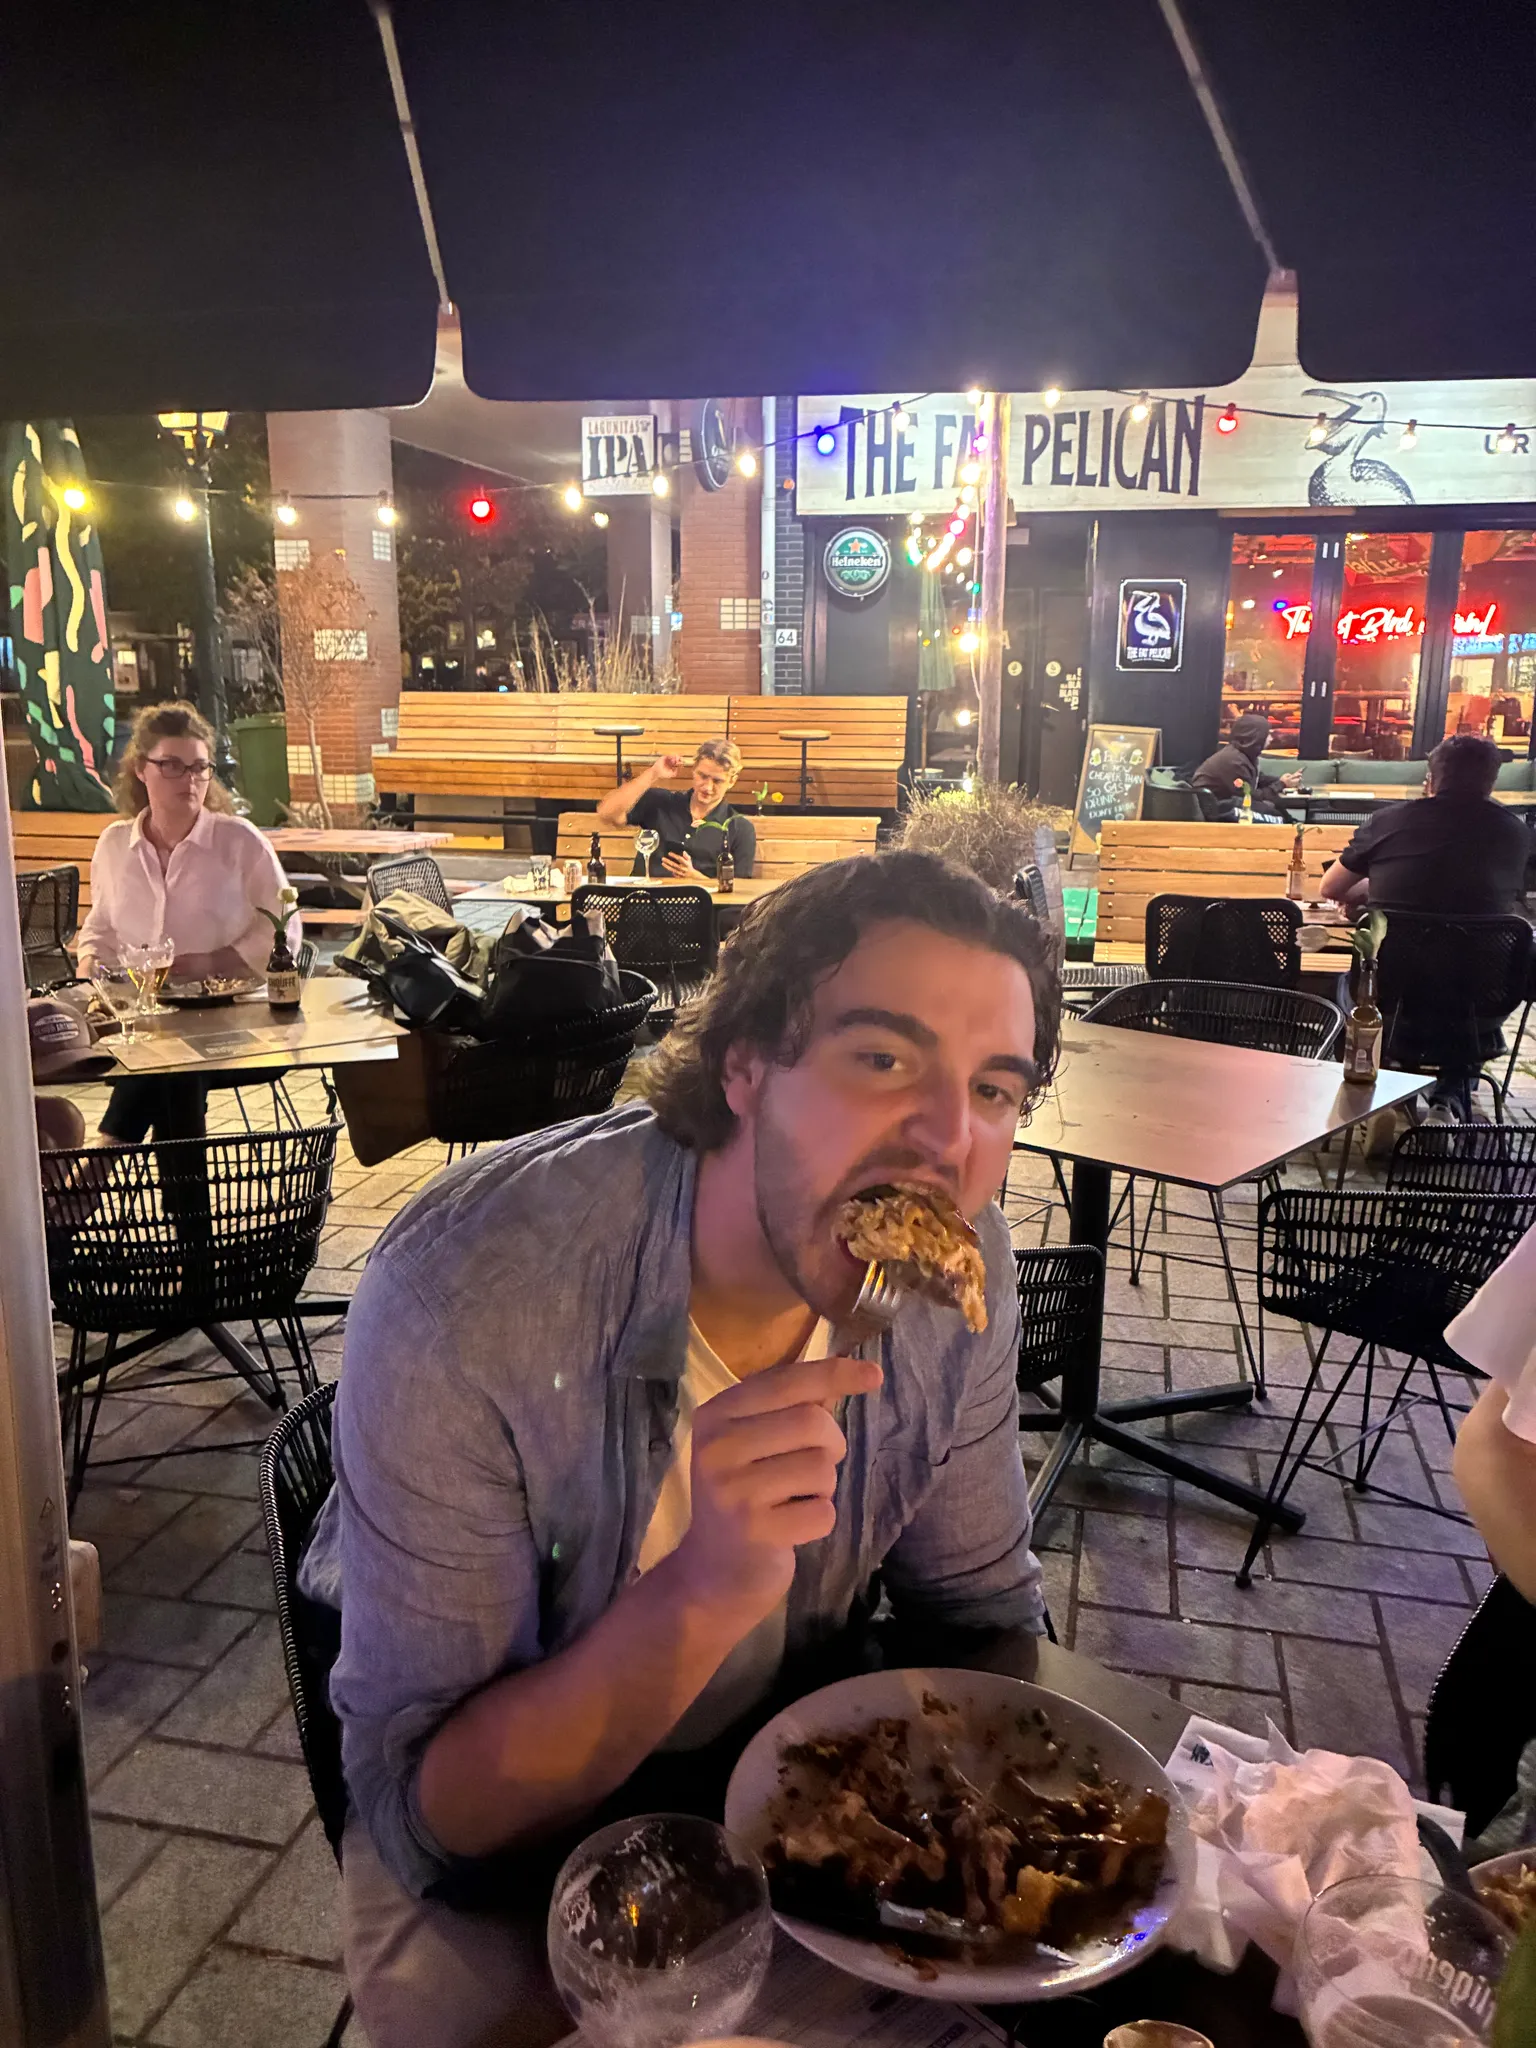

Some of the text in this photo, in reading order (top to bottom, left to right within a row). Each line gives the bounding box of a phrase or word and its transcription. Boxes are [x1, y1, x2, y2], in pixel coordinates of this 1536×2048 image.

[588, 420, 640, 435] LAGUNITAS
[839, 394, 1206, 501] THE FA PELICAN
[587, 434, 649, 479] IPA
[831, 556, 883, 567] Heineken
[777, 631, 794, 644] 64
